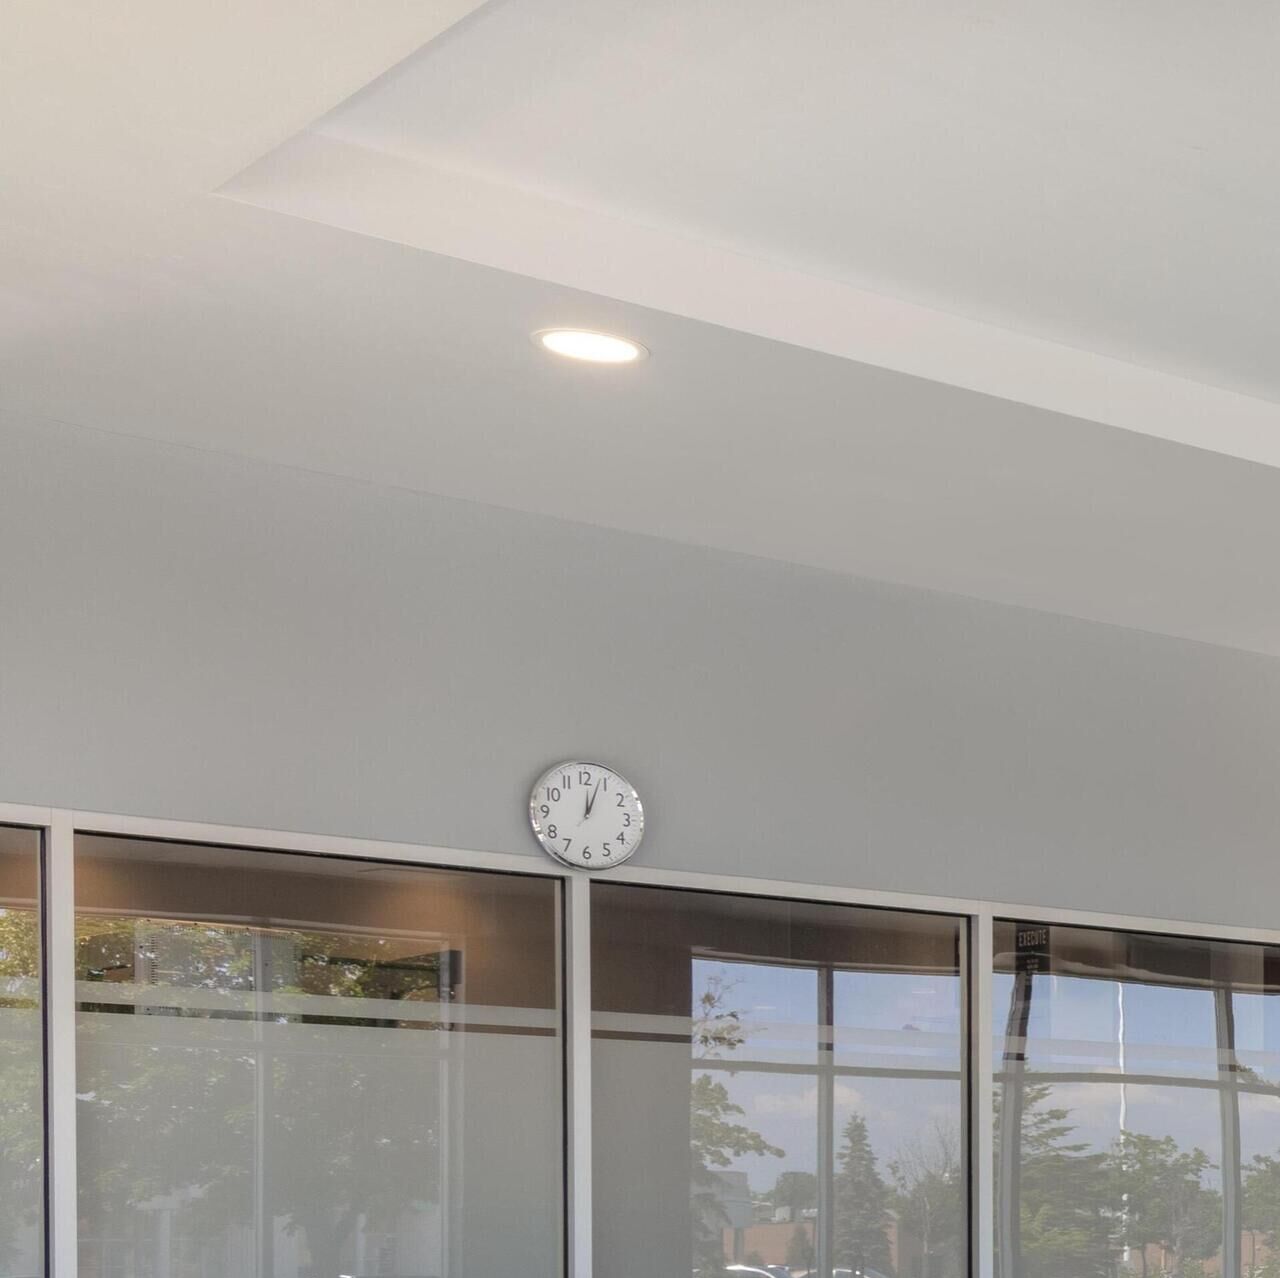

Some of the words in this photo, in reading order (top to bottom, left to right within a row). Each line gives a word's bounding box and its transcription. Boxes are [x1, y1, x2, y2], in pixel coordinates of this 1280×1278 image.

[563, 775, 571, 789] 11
[579, 771, 592, 786] 12
[546, 787, 561, 802] 10
[616, 793, 625, 807] 2
[540, 805, 550, 818] 9
[623, 813, 631, 827] 3
[547, 824, 557, 839] 8
[616, 832, 625, 845] 4
[563, 838, 572, 852] 7
[602, 843, 611, 857] 5
[582, 846, 592, 860] 6
